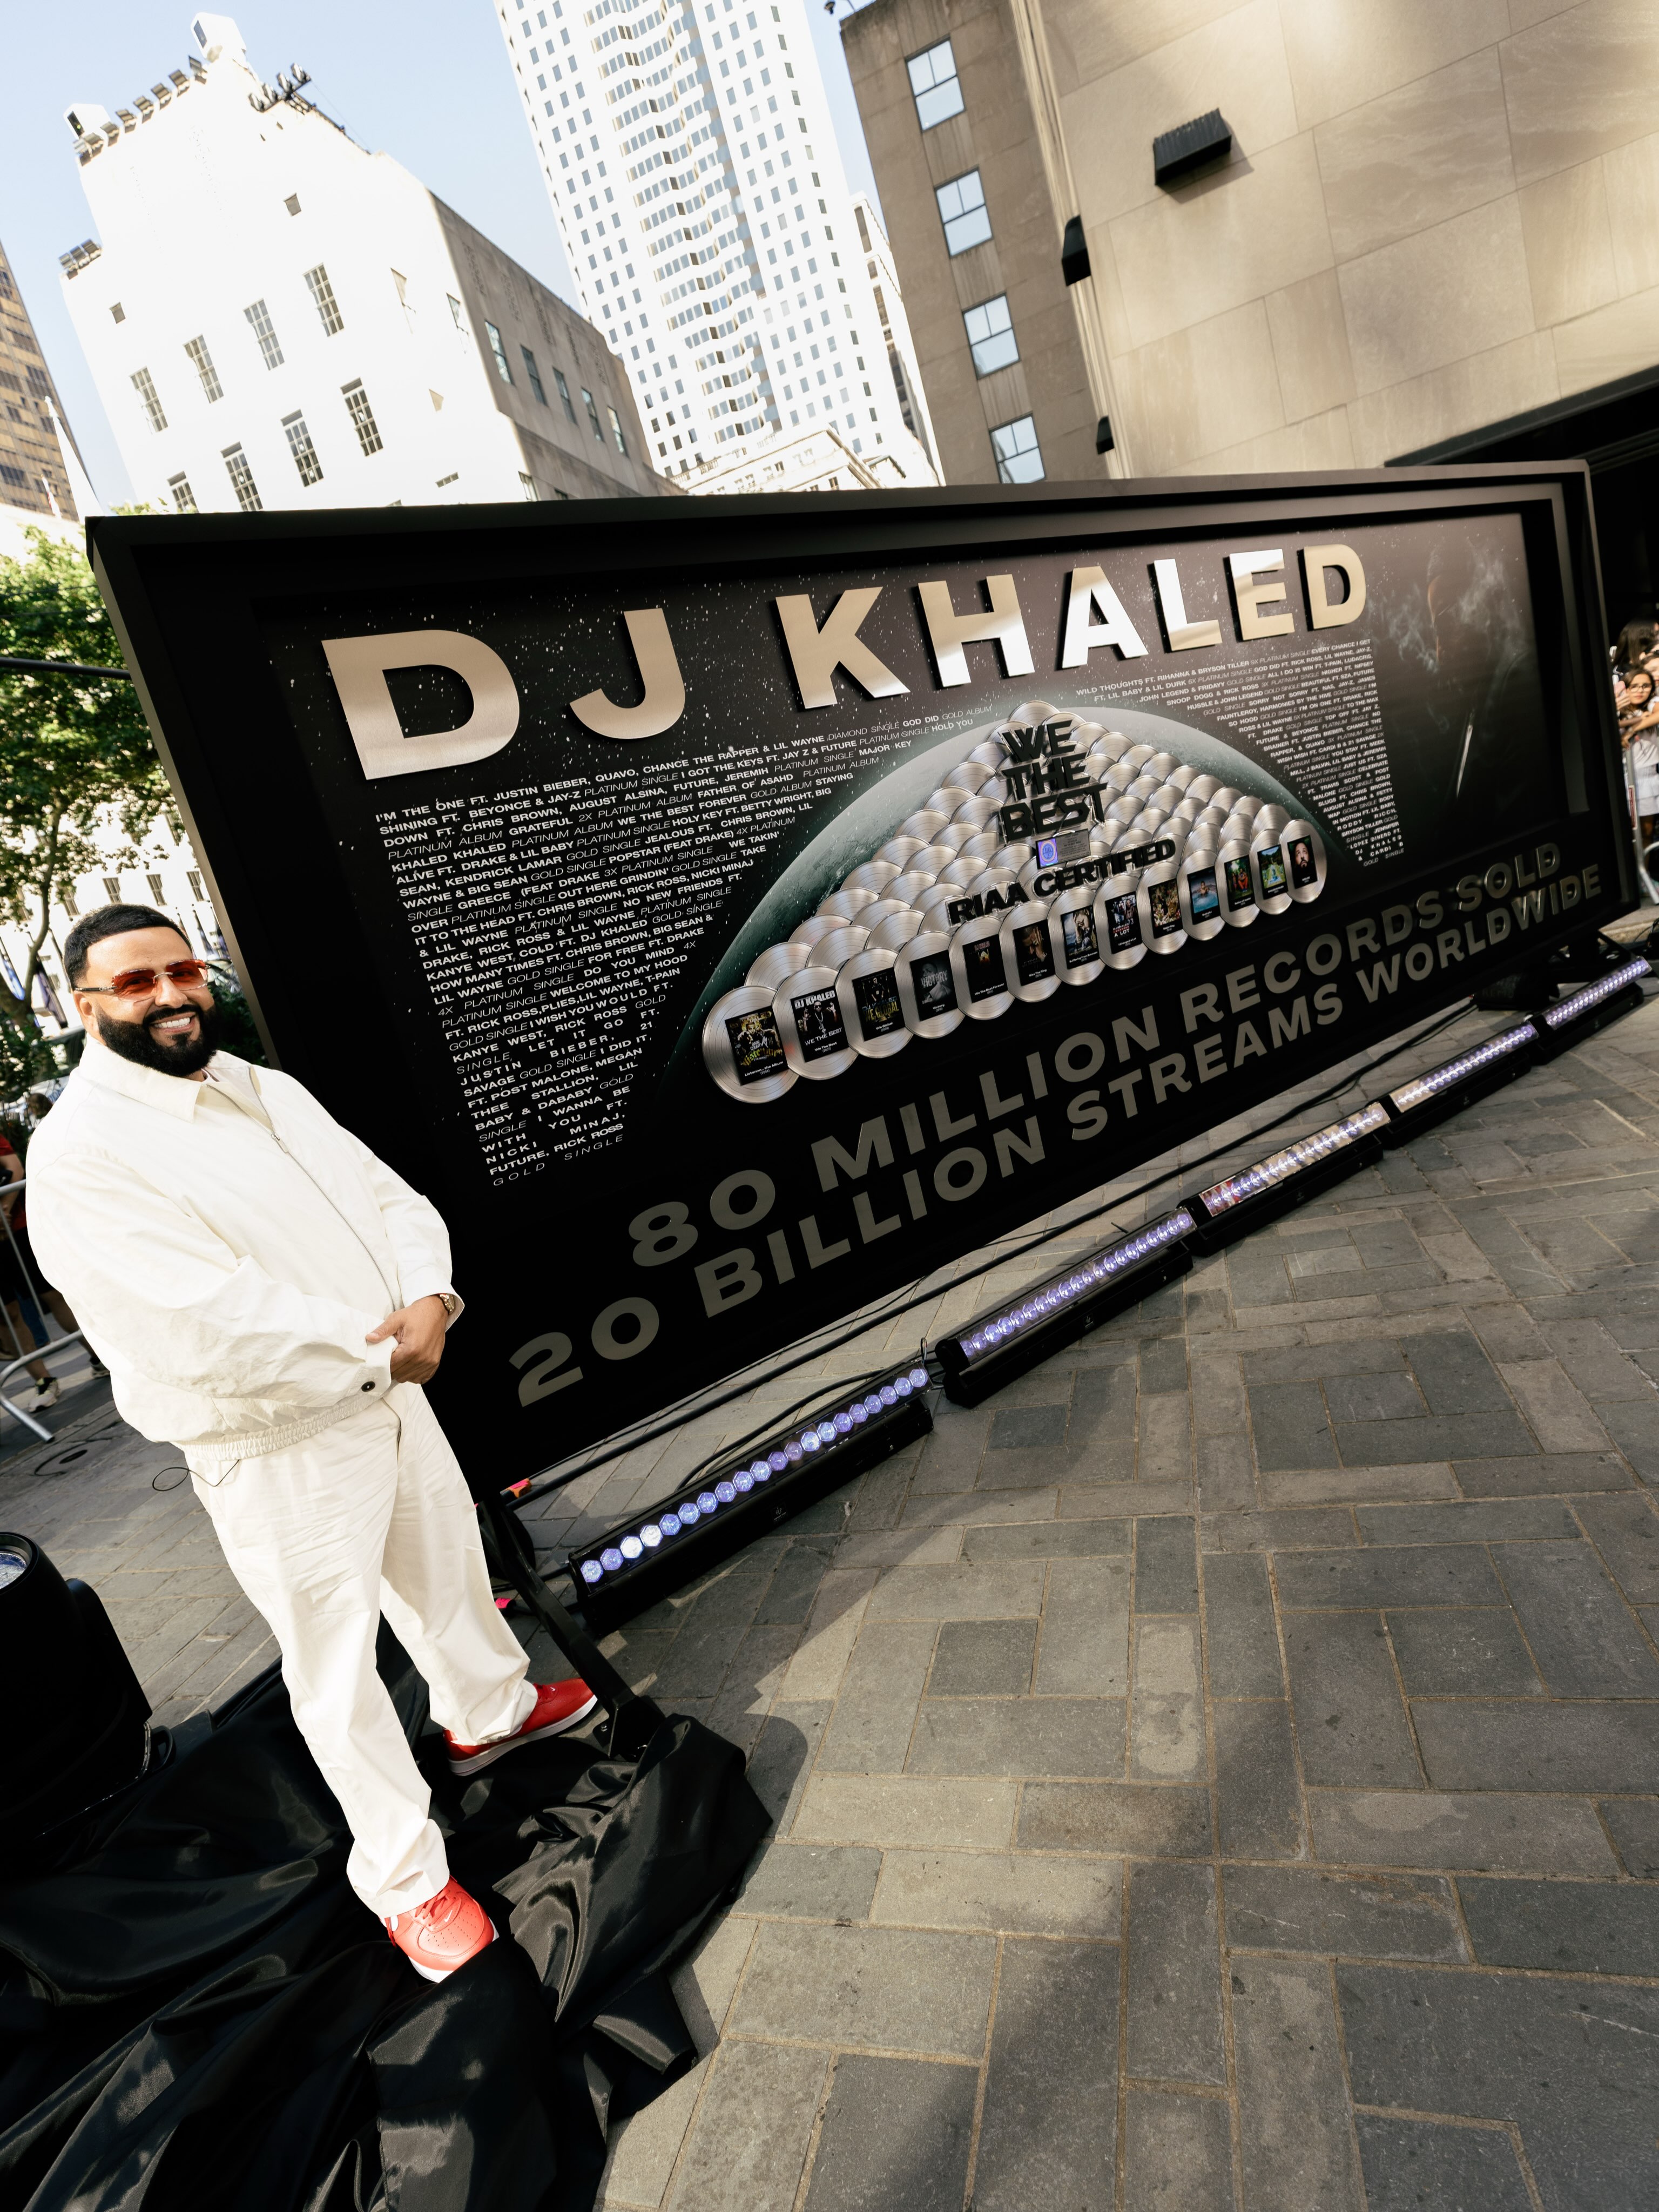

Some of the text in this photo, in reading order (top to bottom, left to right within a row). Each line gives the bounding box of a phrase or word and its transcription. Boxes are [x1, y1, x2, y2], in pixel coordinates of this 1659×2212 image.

[321, 542, 1368, 781] DJ KHALED
[1166, 696, 1190, 705] SNOOP
[1193, 692, 1213, 700] DOGG
[1271, 676, 1298, 685] PLATINUM
[1301, 671, 1319, 679] SINGLE
[1321, 667, 1343, 675] HIGHER
[1354, 660, 1373, 669] NIPSEY
[1001, 719, 1076, 762] WE
[1263, 741, 1289, 751] BRAINER
[1302, 733, 1321, 741] JUSTIN
[1346, 721, 1368, 730] CHANCE
[1363, 746, 1386, 756] JEREMIH
[383, 832, 428, 847] DOWN
[436, 827, 455, 837] FT.
[462, 818, 503, 831] CHRIS
[511, 807, 562, 822] BROWN,
[570, 796, 617, 811] AUGUST
[625, 787, 667, 800] ALSINA,
[673, 778, 718, 791] FUTURE,
[725, 767, 768, 781] JEREMIH
[774, 758, 818, 772] PLATINUM
[824, 751, 853, 762] SINGLE
[859, 745, 890, 756] MAJOR
[1001, 752, 1091, 800] THE
[1318, 797, 1336, 806] SLUGS
[1350, 788, 1367, 797] CHRIS
[1001, 782, 1108, 842] BEST
[1341, 826, 1364, 837] BRYSON
[1365, 819, 1382, 828] TILLER
[399, 882, 441, 896] SEAN,
[445, 866, 514, 887] KENDRICK
[518, 856, 562, 871] LAMAR
[567, 848, 598, 860] GOLD
[603, 839, 640, 853] SINGLE
[645, 827, 694, 844] JEALOUS
[698, 824, 712, 832] FT.
[720, 815, 752, 827] CHRIS
[756, 806, 795, 820] BROWN,
[1371, 835, 1401, 848] KHALED
[415, 859, 753, 945] IT TO THE HEAD FT. CHRIS BROWN, RICK ROSS, NICKI MINAJ
[948, 882, 1030, 925] RIAA
[1034, 838, 1176, 898] CERTIFIED
[434, 927, 704, 1004] LIL WAYNE GOLD SINGLE FOR FREE FT. DRAKE
[453, 995, 665, 1062] KANYE WEST, RICK ROSS GOLD
[794, 999, 804, 1009] DJ
[875, 1001, 899, 1018] GLOBAL
[628, 842, 1561, 1267] 80 MILLION RECORDS SOLD
[828, 1027, 842, 1036] BEST
[468, 1048, 642, 1108] FT. POST MALONE, MEGAN
[489, 1123, 623, 1175] FUTURE, RICK ROSS
[509, 865, 1602, 1407] 20 BILLION STREAMS WORLDWIDE
